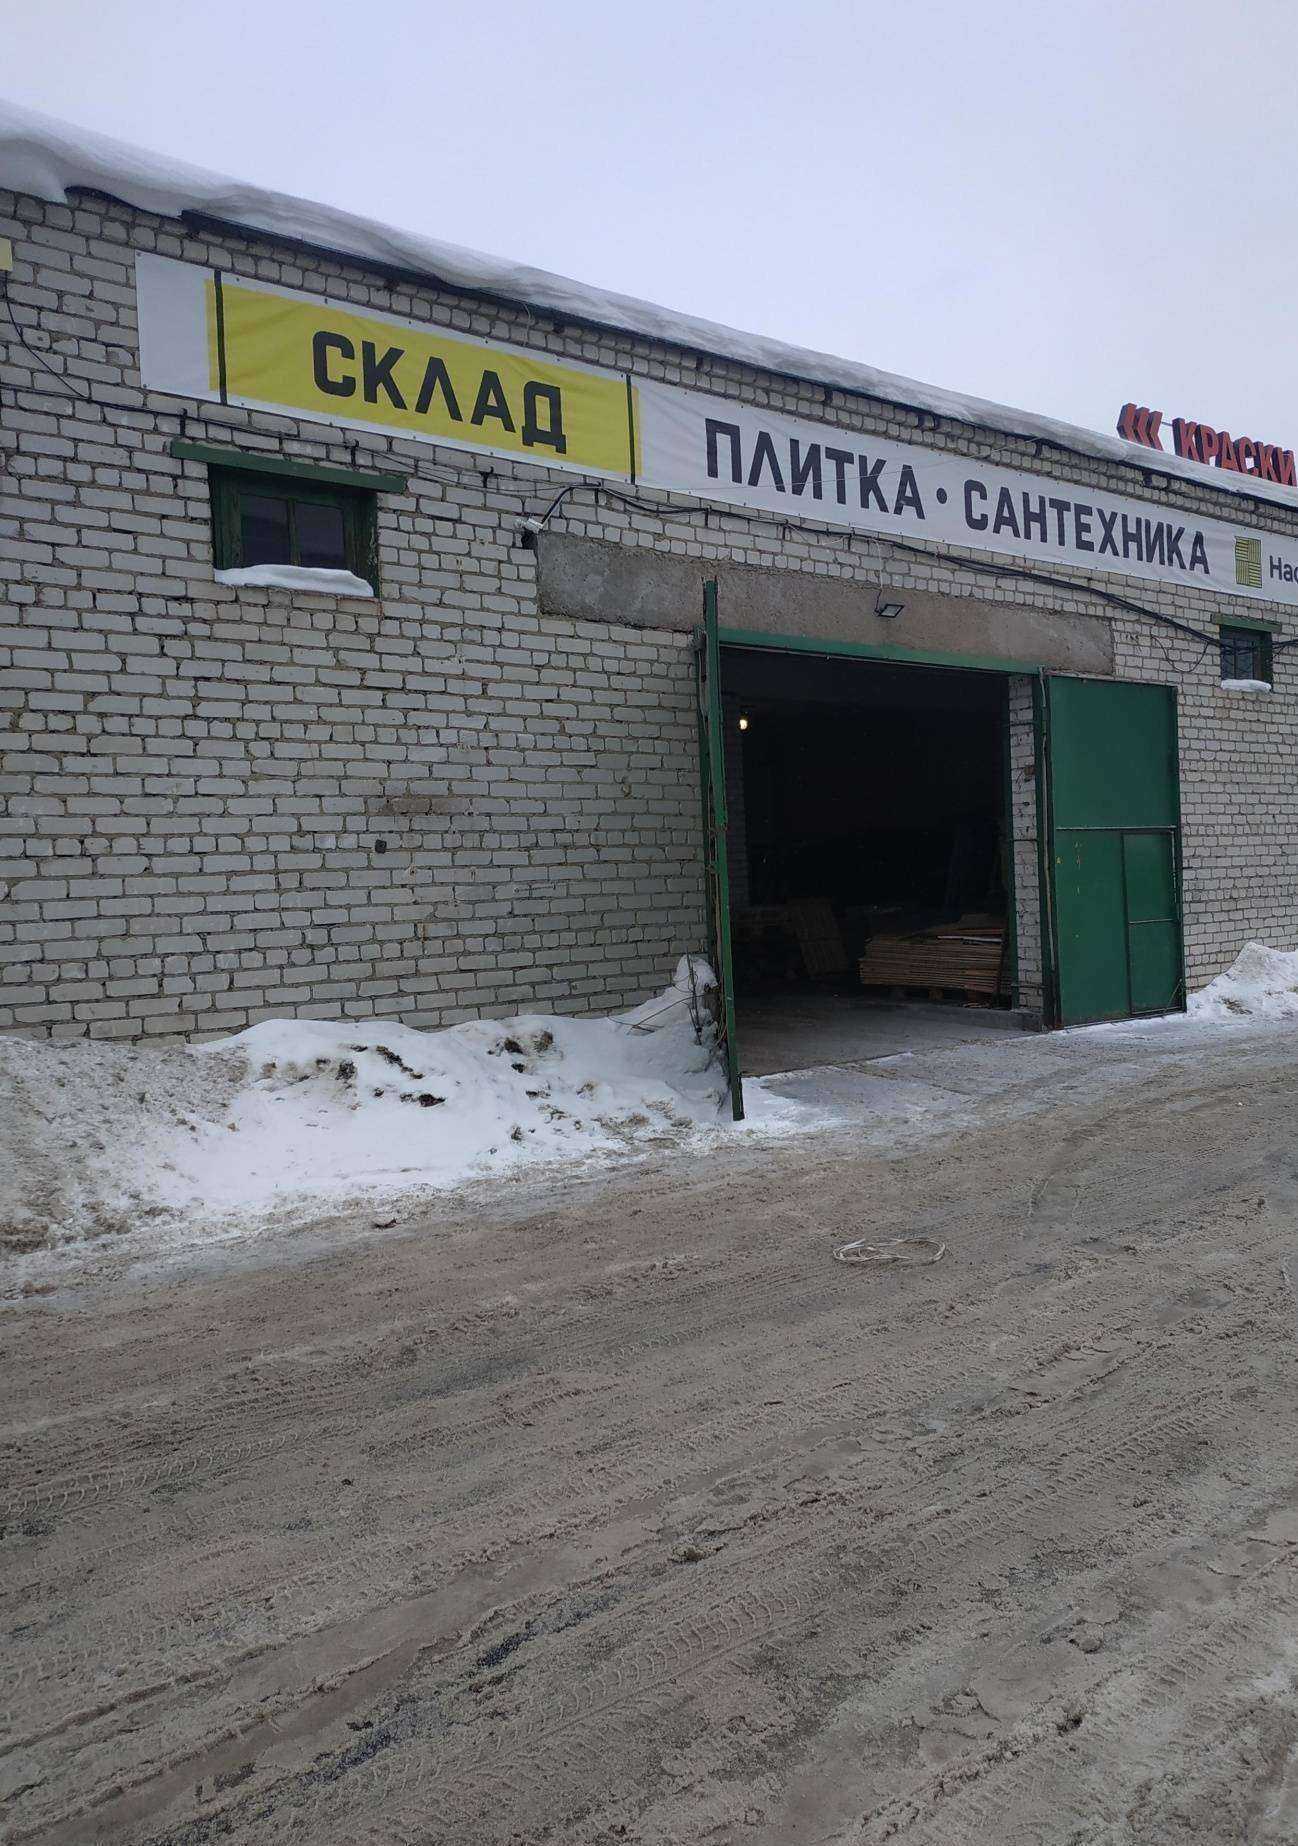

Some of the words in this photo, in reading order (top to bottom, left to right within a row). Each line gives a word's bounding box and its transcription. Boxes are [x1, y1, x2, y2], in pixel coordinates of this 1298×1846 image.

[313, 330, 567, 454] СКЛАД
[1172, 417, 1298, 487] КРАСКИ
[705, 417, 926, 520] ПЛИТКА
[964, 479, 1210, 575] САНТЕХНИКА
